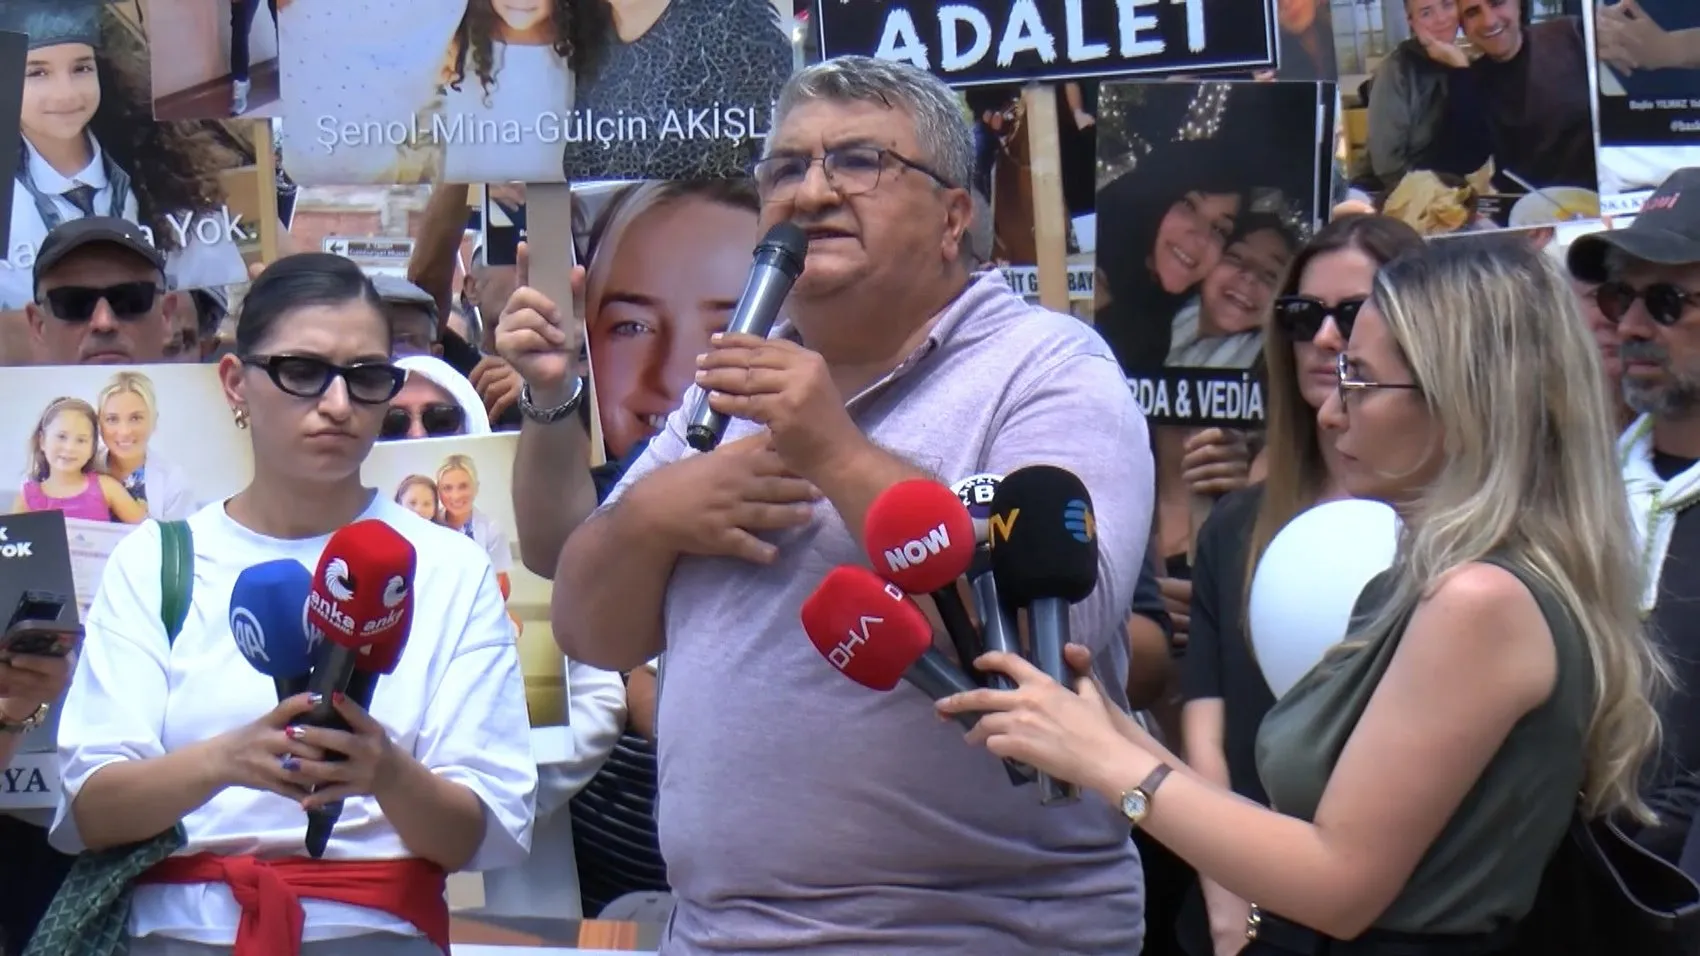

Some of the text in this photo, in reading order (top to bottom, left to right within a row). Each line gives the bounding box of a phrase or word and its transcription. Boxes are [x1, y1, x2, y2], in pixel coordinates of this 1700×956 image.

[874, 0, 1207, 73] ADALET
[315, 109, 647, 153] Şenol-Mina-Gülçin
[166, 205, 258, 248] Yok.
[1175, 379, 1192, 418] &
[1196, 372, 1265, 420] VEDİA
[974, 484, 995, 504] B
[0, 542, 33, 557] OK
[884, 523, 951, 573] NOW
[310, 590, 356, 630] anka
[828, 615, 885, 670] DHA
[0, 767, 51, 794] YA
